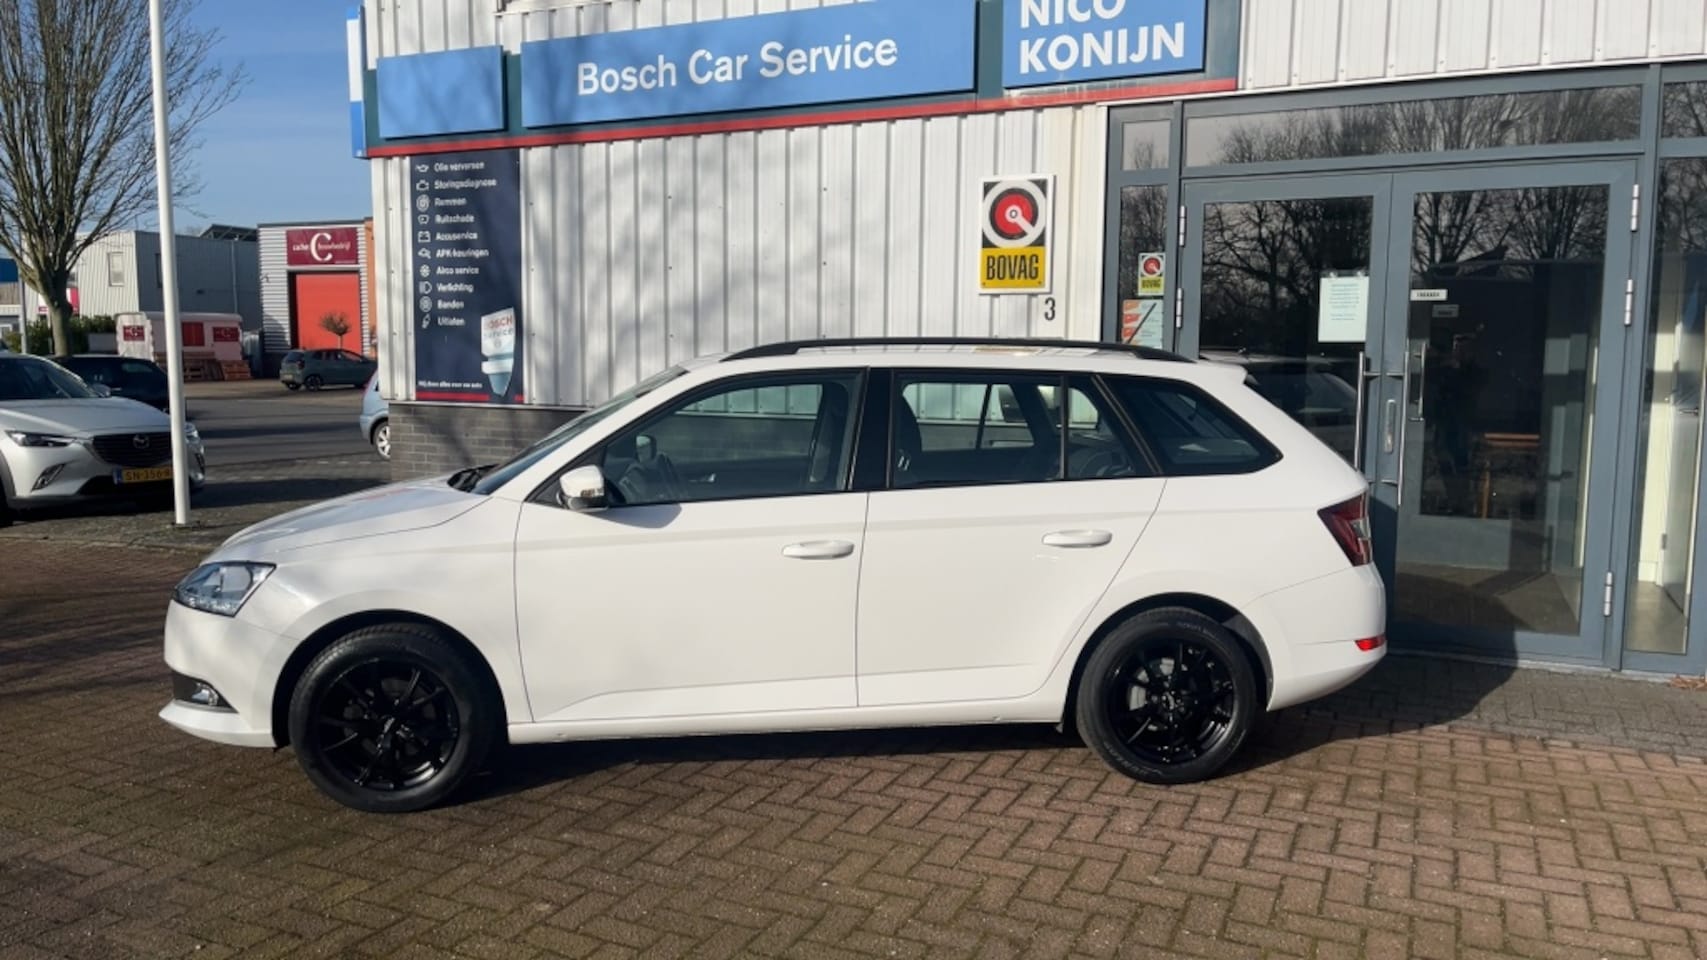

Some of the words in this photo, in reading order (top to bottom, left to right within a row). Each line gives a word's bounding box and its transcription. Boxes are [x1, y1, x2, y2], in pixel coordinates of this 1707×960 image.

[1021, 0, 1125, 28] NICO
[1020, 22, 1185, 74] KONIJN
[577, 55, 676, 95] Bosch
[688, 49, 748, 85] Car
[760, 34, 897, 78] Service
[455, 266, 479, 275] service
[986, 254, 1039, 280] BOVAG
[1141, 279, 1161, 289] BOVAG
[1044, 297, 1056, 321] 3
